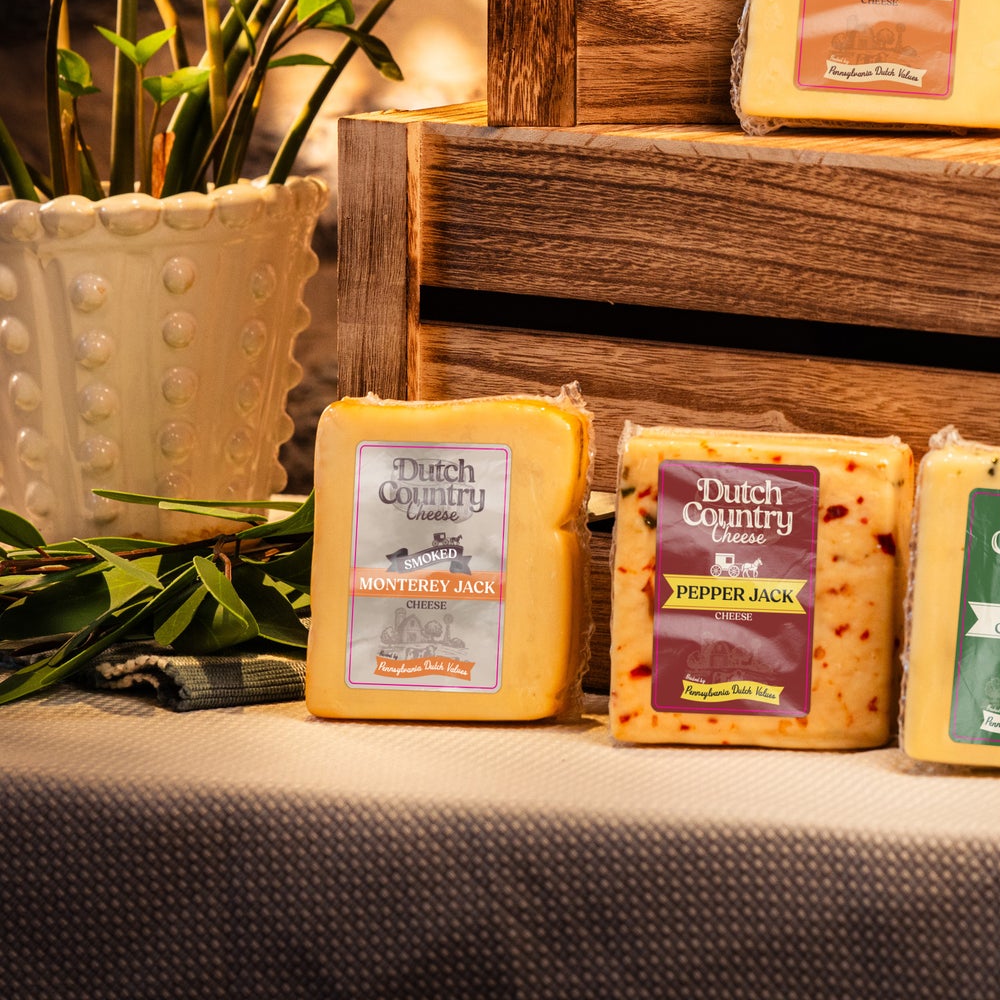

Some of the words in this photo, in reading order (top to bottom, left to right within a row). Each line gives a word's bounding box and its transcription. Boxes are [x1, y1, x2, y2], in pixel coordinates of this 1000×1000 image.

[828, 66, 872, 79] Pennsylvania
[874, 66, 895, 77] Dutch
[898, 69, 919, 82] Values
[393, 458, 475, 483] Dutch
[379, 481, 485, 513] Country
[697, 478, 783, 505] Dutch
[406, 501, 459, 521] Cheese
[682, 501, 793, 536] Country
[712, 522, 766, 544] Cheese
[404, 548, 457, 570] SMOKED
[359, 577, 450, 592] MONTEREY
[454, 580, 495, 594] JACK
[676, 585, 745, 601] PEPPER
[749, 588, 794, 603] JACK
[406, 600, 447, 610] CHEESE
[715, 612, 752, 621] CHEESE
[378, 662, 422, 675] Pennsylvania
[424, 660, 444, 670] Dutch
[447, 663, 468, 675] Values
[685, 686, 730, 699] Pennsylvania
[731, 684, 751, 694] Dutch
[755, 686, 776, 699] Values
